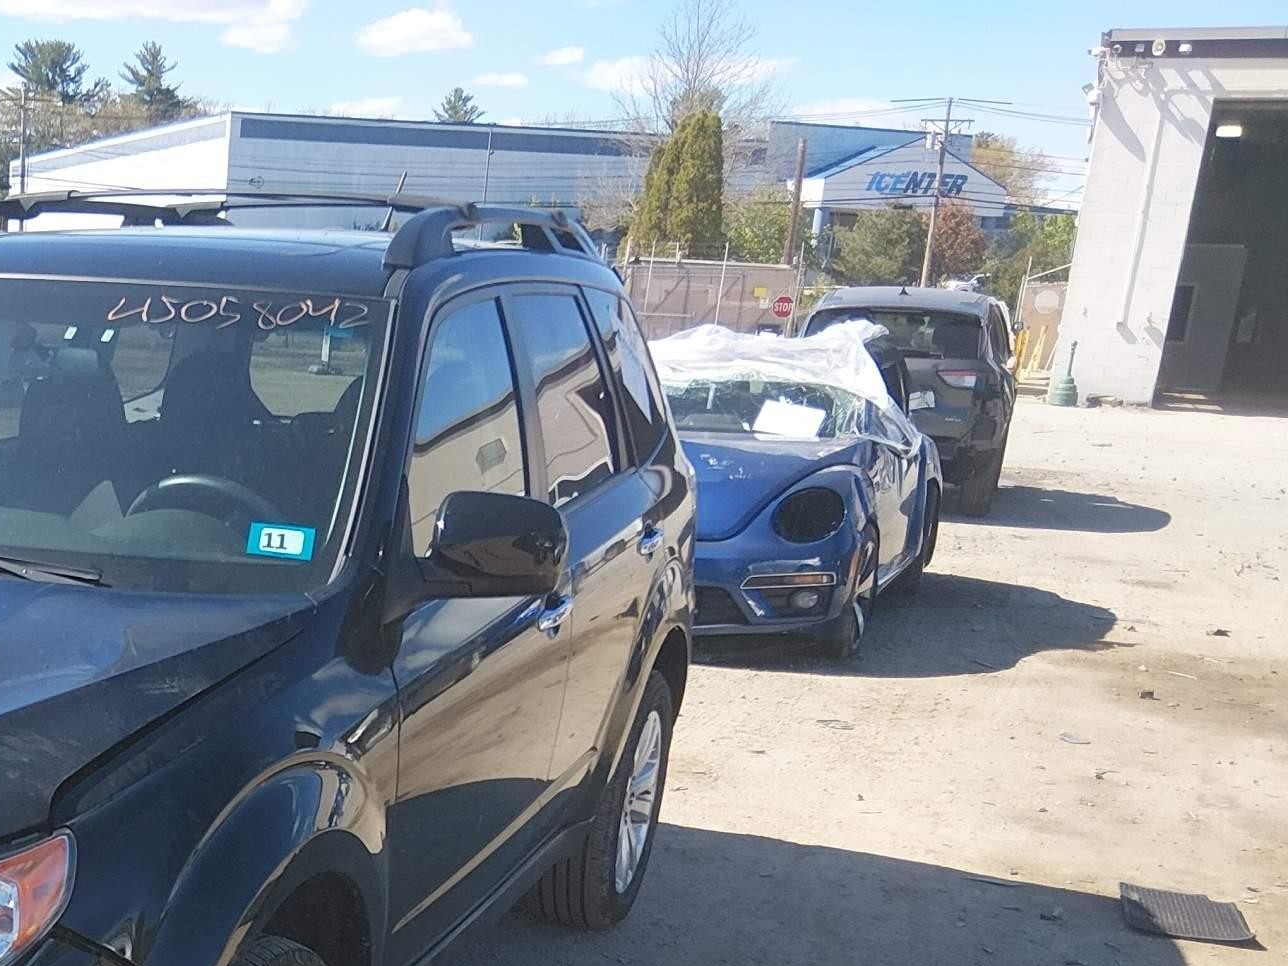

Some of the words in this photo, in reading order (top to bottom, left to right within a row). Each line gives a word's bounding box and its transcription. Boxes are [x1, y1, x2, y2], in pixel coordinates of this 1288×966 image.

[866, 171, 968, 196] ICENTER
[774, 302, 794, 312] STOP
[262, 532, 287, 550] 11
